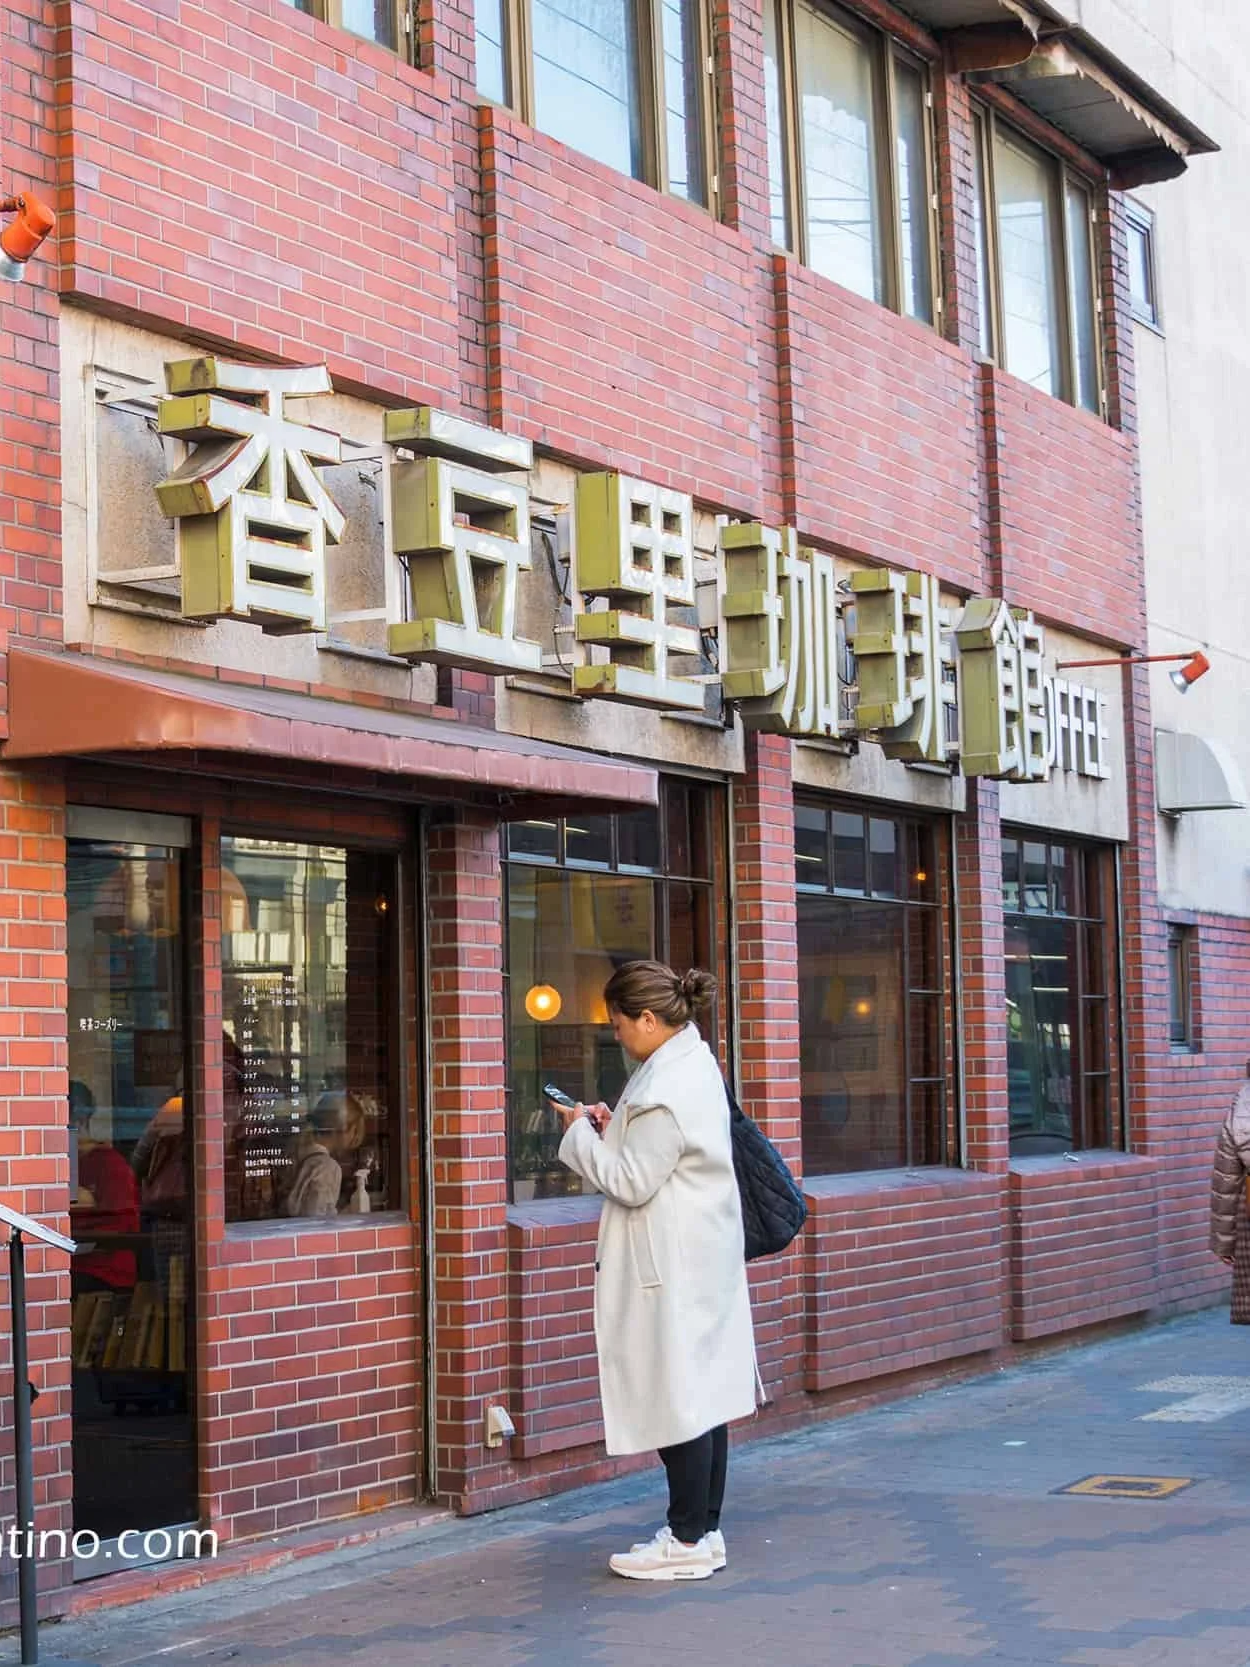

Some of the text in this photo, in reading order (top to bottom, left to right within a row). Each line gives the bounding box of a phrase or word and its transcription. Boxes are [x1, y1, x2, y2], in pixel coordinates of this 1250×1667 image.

[155, 355, 1050, 783] 香豆里珈琲館
